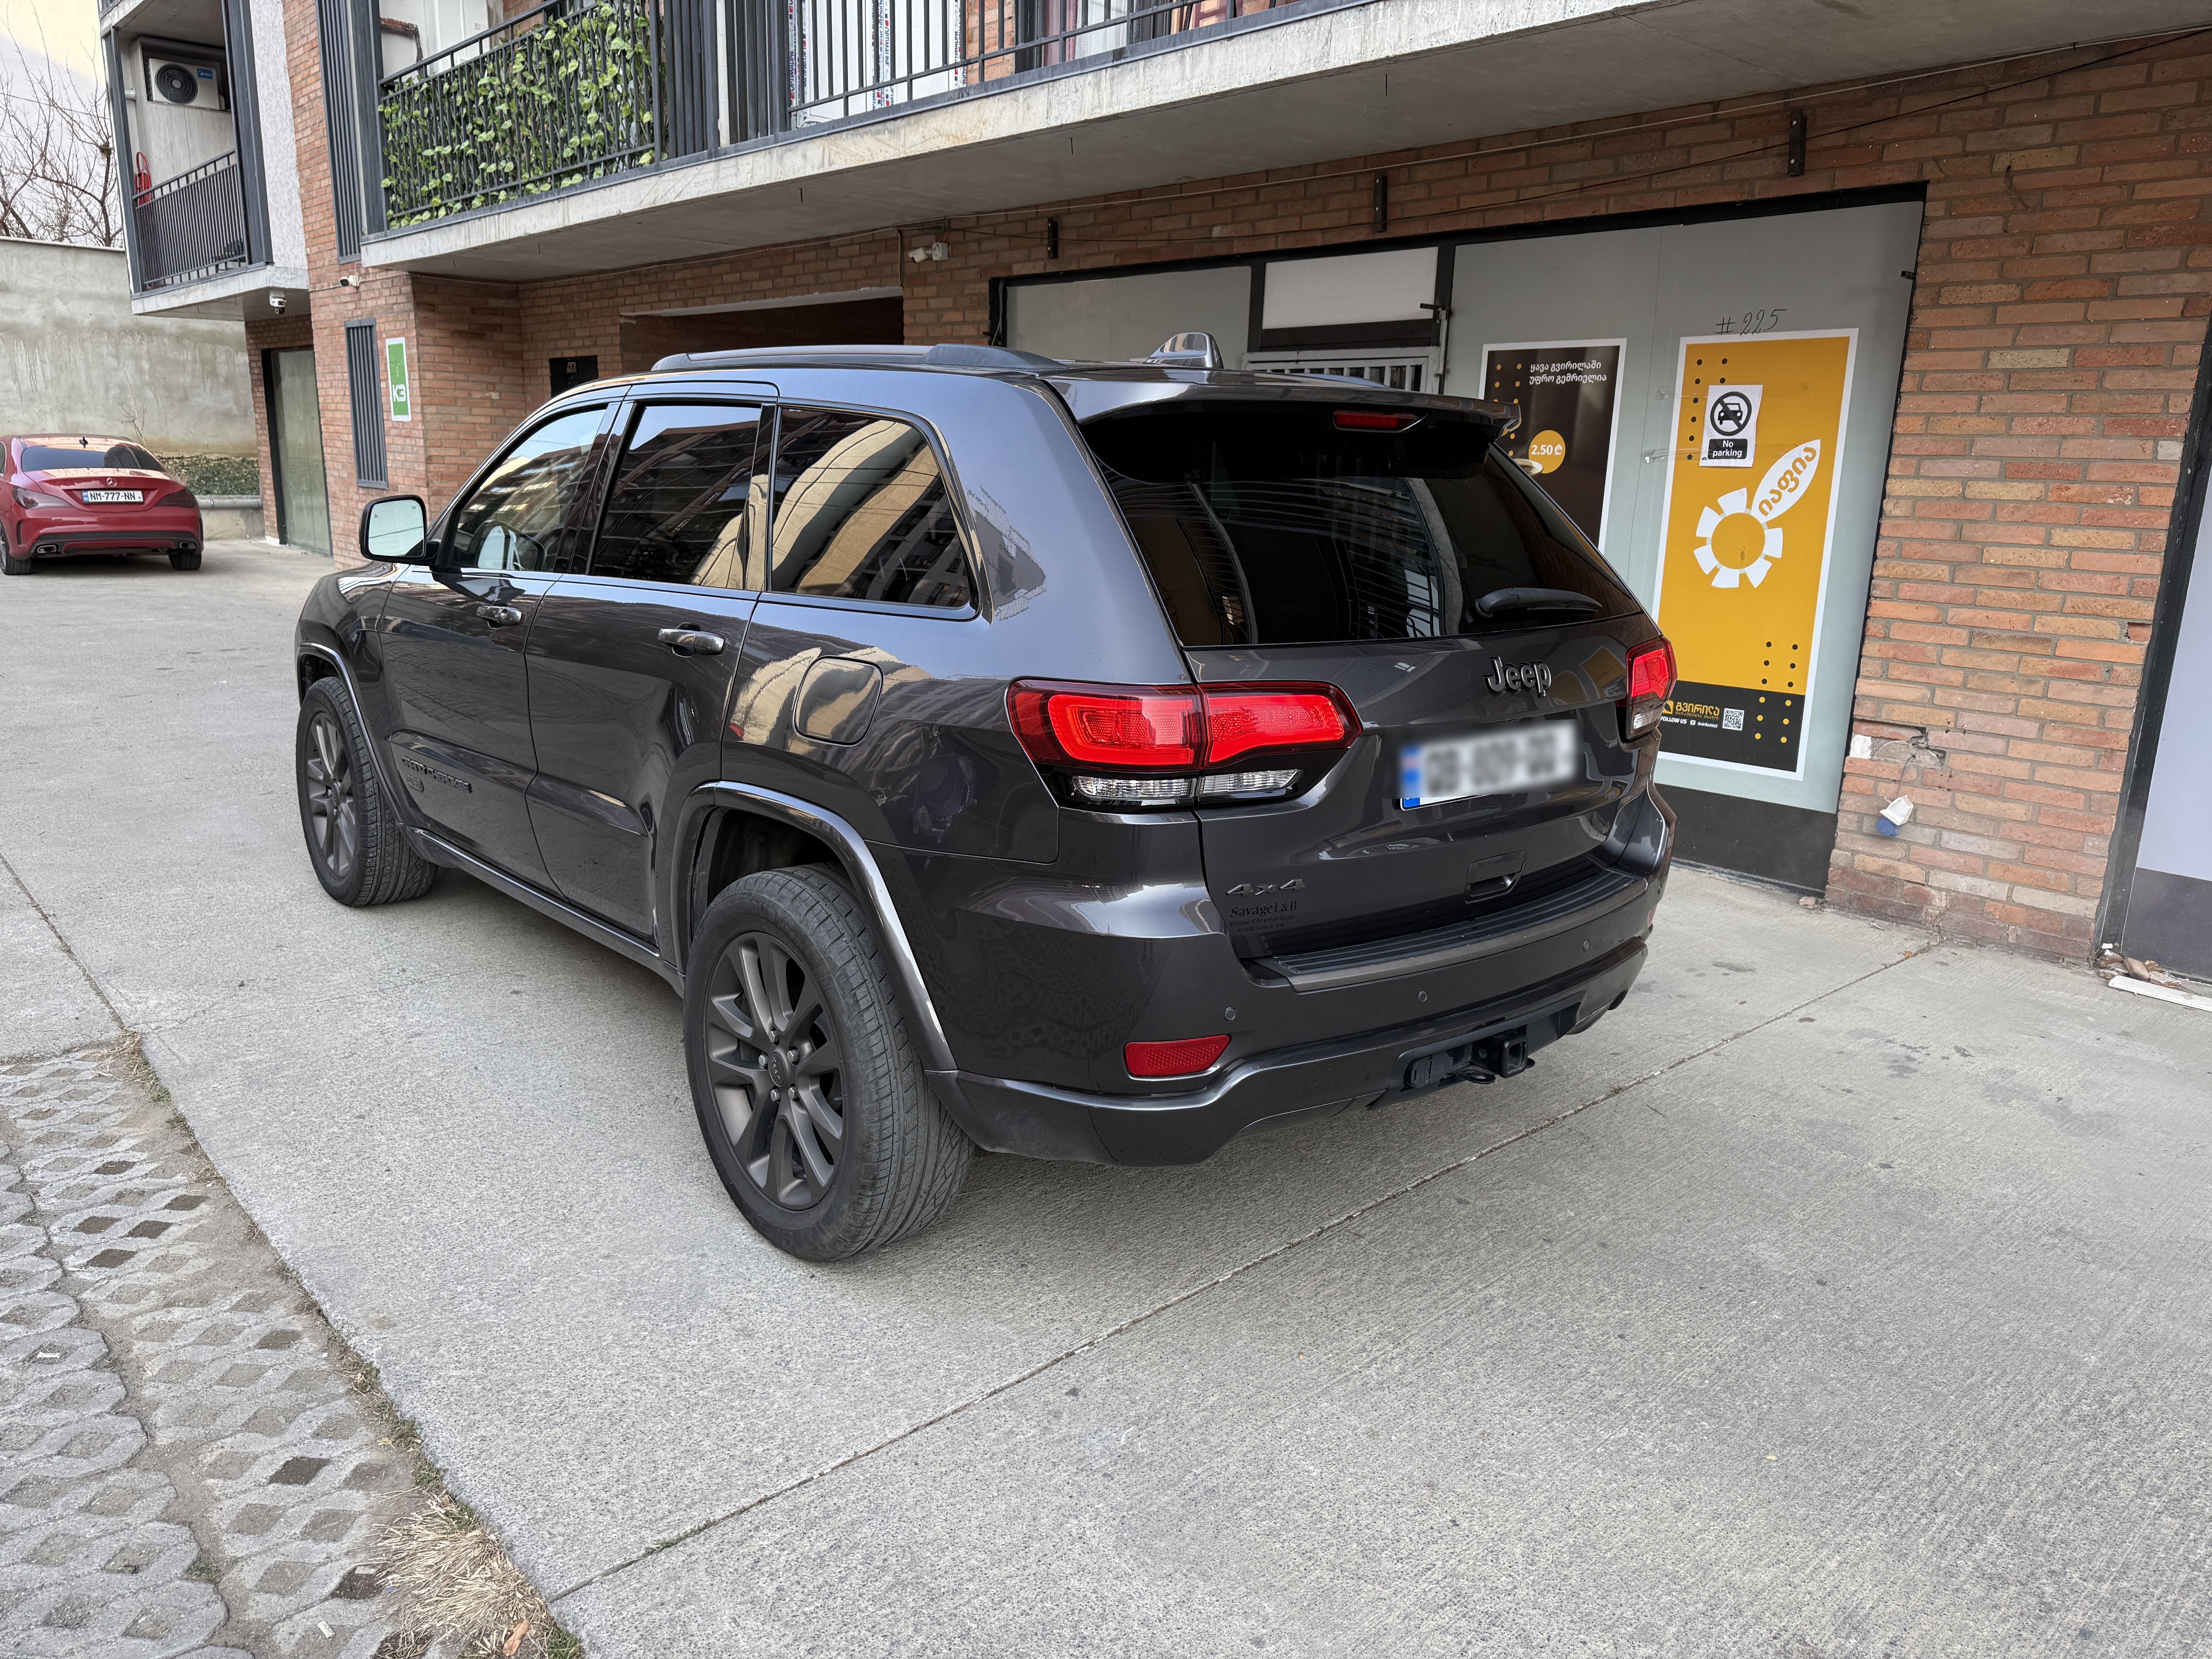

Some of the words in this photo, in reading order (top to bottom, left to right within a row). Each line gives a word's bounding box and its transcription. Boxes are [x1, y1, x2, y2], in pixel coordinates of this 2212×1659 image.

[1530, 363, 1549, 373] ყავა
[1551, 360, 1601, 372] გვირილაში
[1529, 374, 1554, 385] უფრო
[1556, 373, 1607, 384] გემრიელია
[392, 384, 406, 402] K3
[1723, 440, 1734, 448] No
[1712, 448, 1742, 458] parking
[1759, 447, 1817, 517] იაფია
[89, 492, 136, 500] NM-777-NN
[1483, 656, 1552, 697] Jeep
[1676, 702, 1720, 716] გვირილა
[1226, 878, 1306, 897] 4x4
[1230, 904, 1273, 918] Savage
